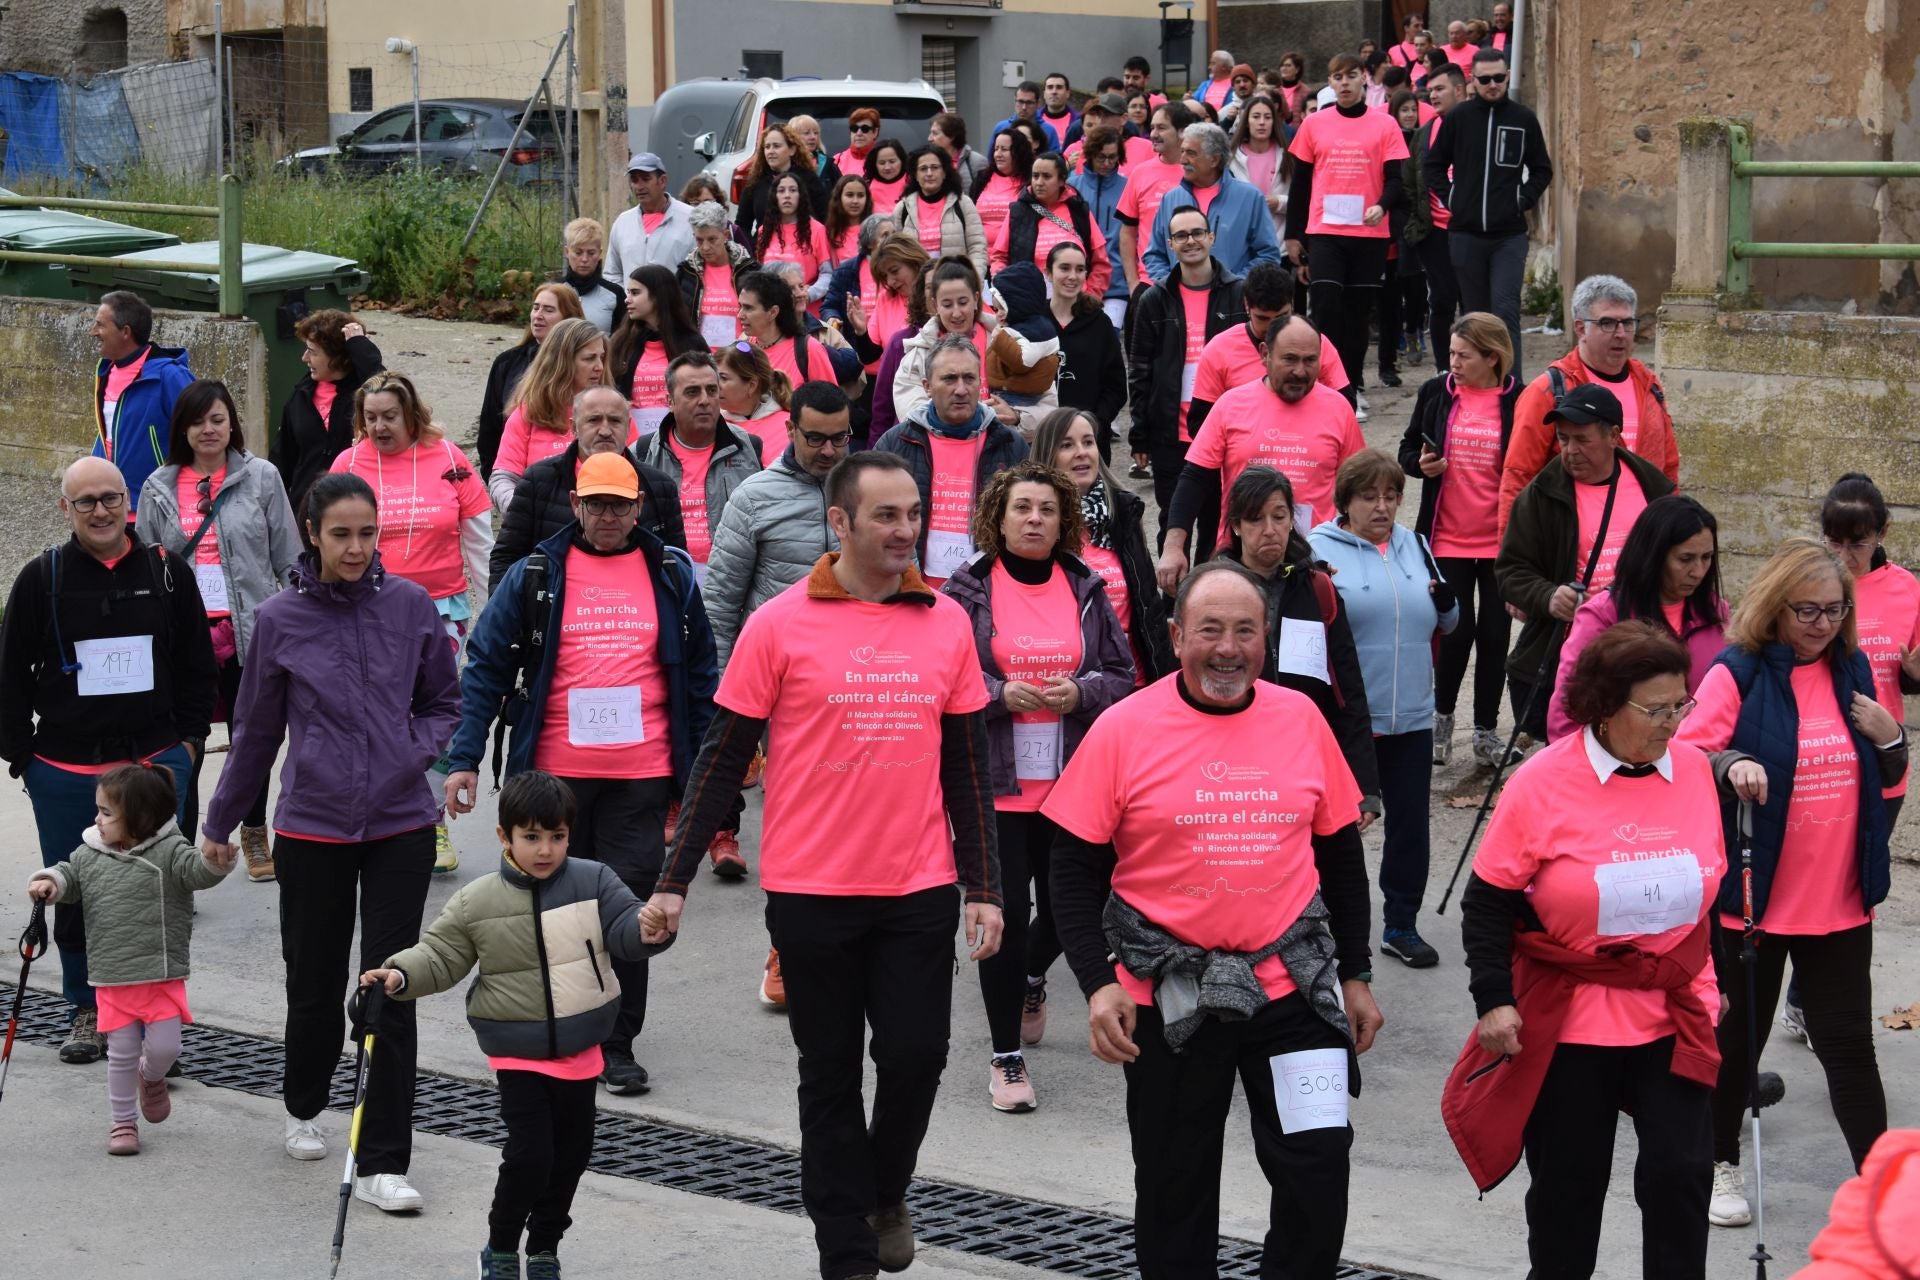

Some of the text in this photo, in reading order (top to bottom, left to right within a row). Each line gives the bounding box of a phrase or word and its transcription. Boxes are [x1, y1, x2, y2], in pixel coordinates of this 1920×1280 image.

[1451, 424, 1500, 438] En marcha
[552, 441, 564, 449] En
[1259, 443, 1308, 454] En marcha
[1470, 439, 1479, 447] el
[1248, 457, 1319, 468] contra el cáncer
[941, 489, 970, 499] march
[693, 508, 702, 518] el
[932, 502, 945, 511] tra
[947, 502, 956, 511] el
[181, 517, 193, 525] En
[943, 545, 967, 559] 112
[576, 604, 638, 616] En marcha
[562, 619, 655, 632] contra el cáncer
[1857, 633, 1892, 646] archa
[103, 651, 132, 674] 197
[1010, 653, 1073, 664] En marcha
[845, 670, 919, 683] En marcha
[1005, 670, 1034, 680] ontra
[1036, 669, 1047, 680] el
[827, 690, 938, 705] contra el cáncer
[588, 707, 618, 724] 269
[854, 711, 884, 719] Marcha
[886, 711, 918, 719] solidaria
[856, 722, 883, 730] Rincón
[894, 722, 923, 730] Olivedo
[1799, 733, 1847, 749] marcha
[1020, 740, 1052, 759] 271
[1813, 753, 1825, 765] el
[1828, 751, 1857, 763] cánc
[1820, 769, 1851, 779] solidaria
[1793, 778, 1856, 791] Rincón de Olivedo
[1195, 787, 1279, 802] En marcha
[1175, 809, 1300, 825] contra el cáncer
[1198, 831, 1277, 840] II Marcha solidaria
[1192, 845, 1204, 853] en
[1208, 844, 1238, 853] Rincón
[1240, 844, 1251, 852] de
[1611, 846, 1691, 862] En marcha
[1644, 883, 1661, 903] 41
[1298, 1073, 1343, 1095] 306
